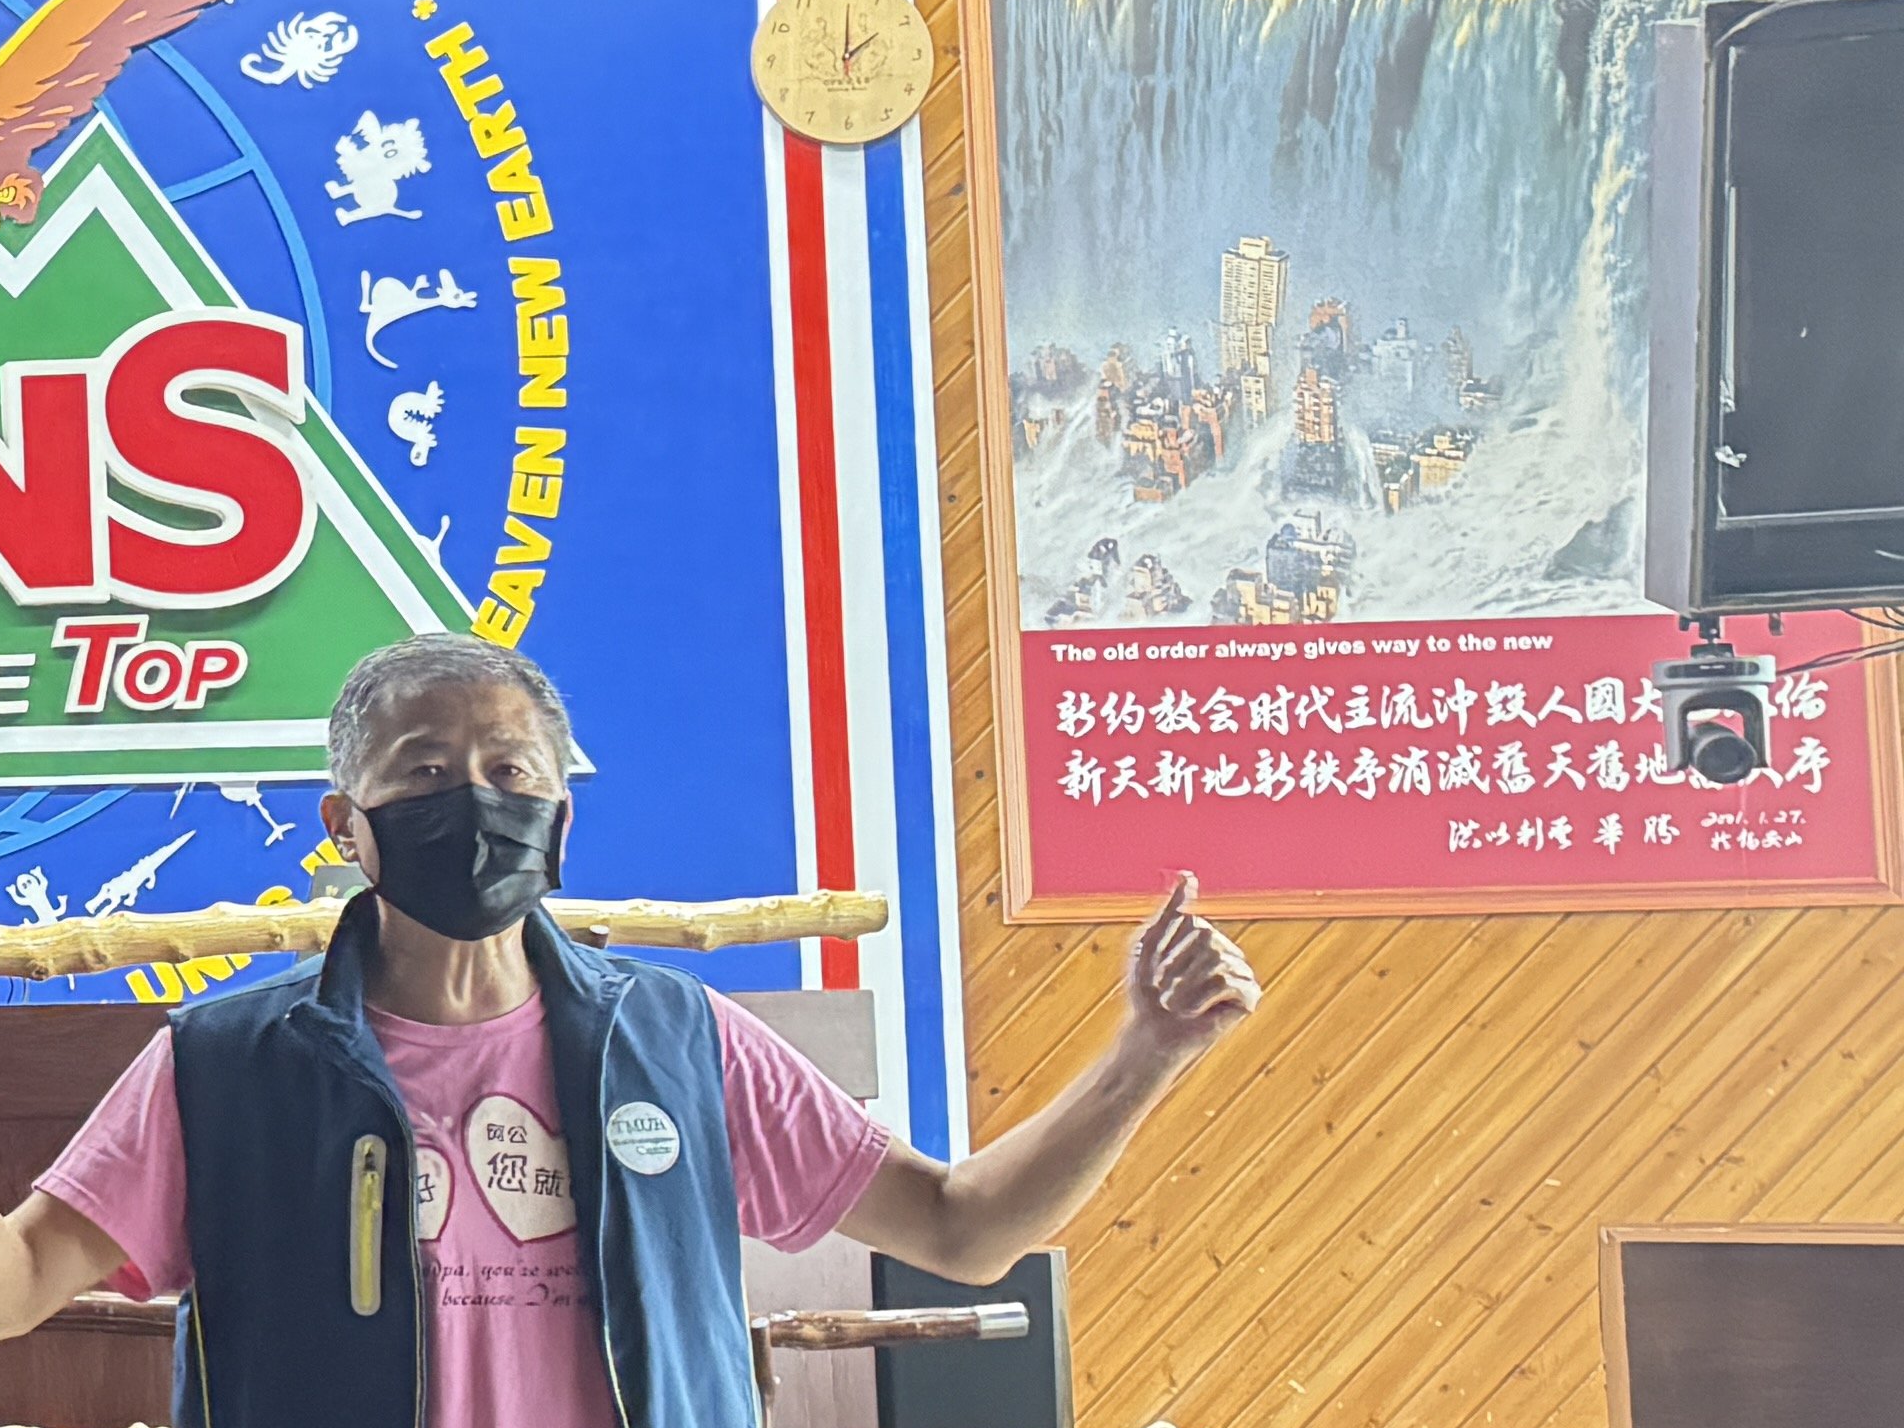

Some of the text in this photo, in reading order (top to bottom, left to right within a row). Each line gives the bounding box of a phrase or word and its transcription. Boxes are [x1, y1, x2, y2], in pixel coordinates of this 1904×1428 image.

[771, 21, 791, 35] 10
[912, 48, 922, 62] 3
[844, 115, 854, 131] 6
[425, 19, 570, 650] EAVEN NEW EARTH
[1050, 632, 1554, 662] The old order always gives way to the new
